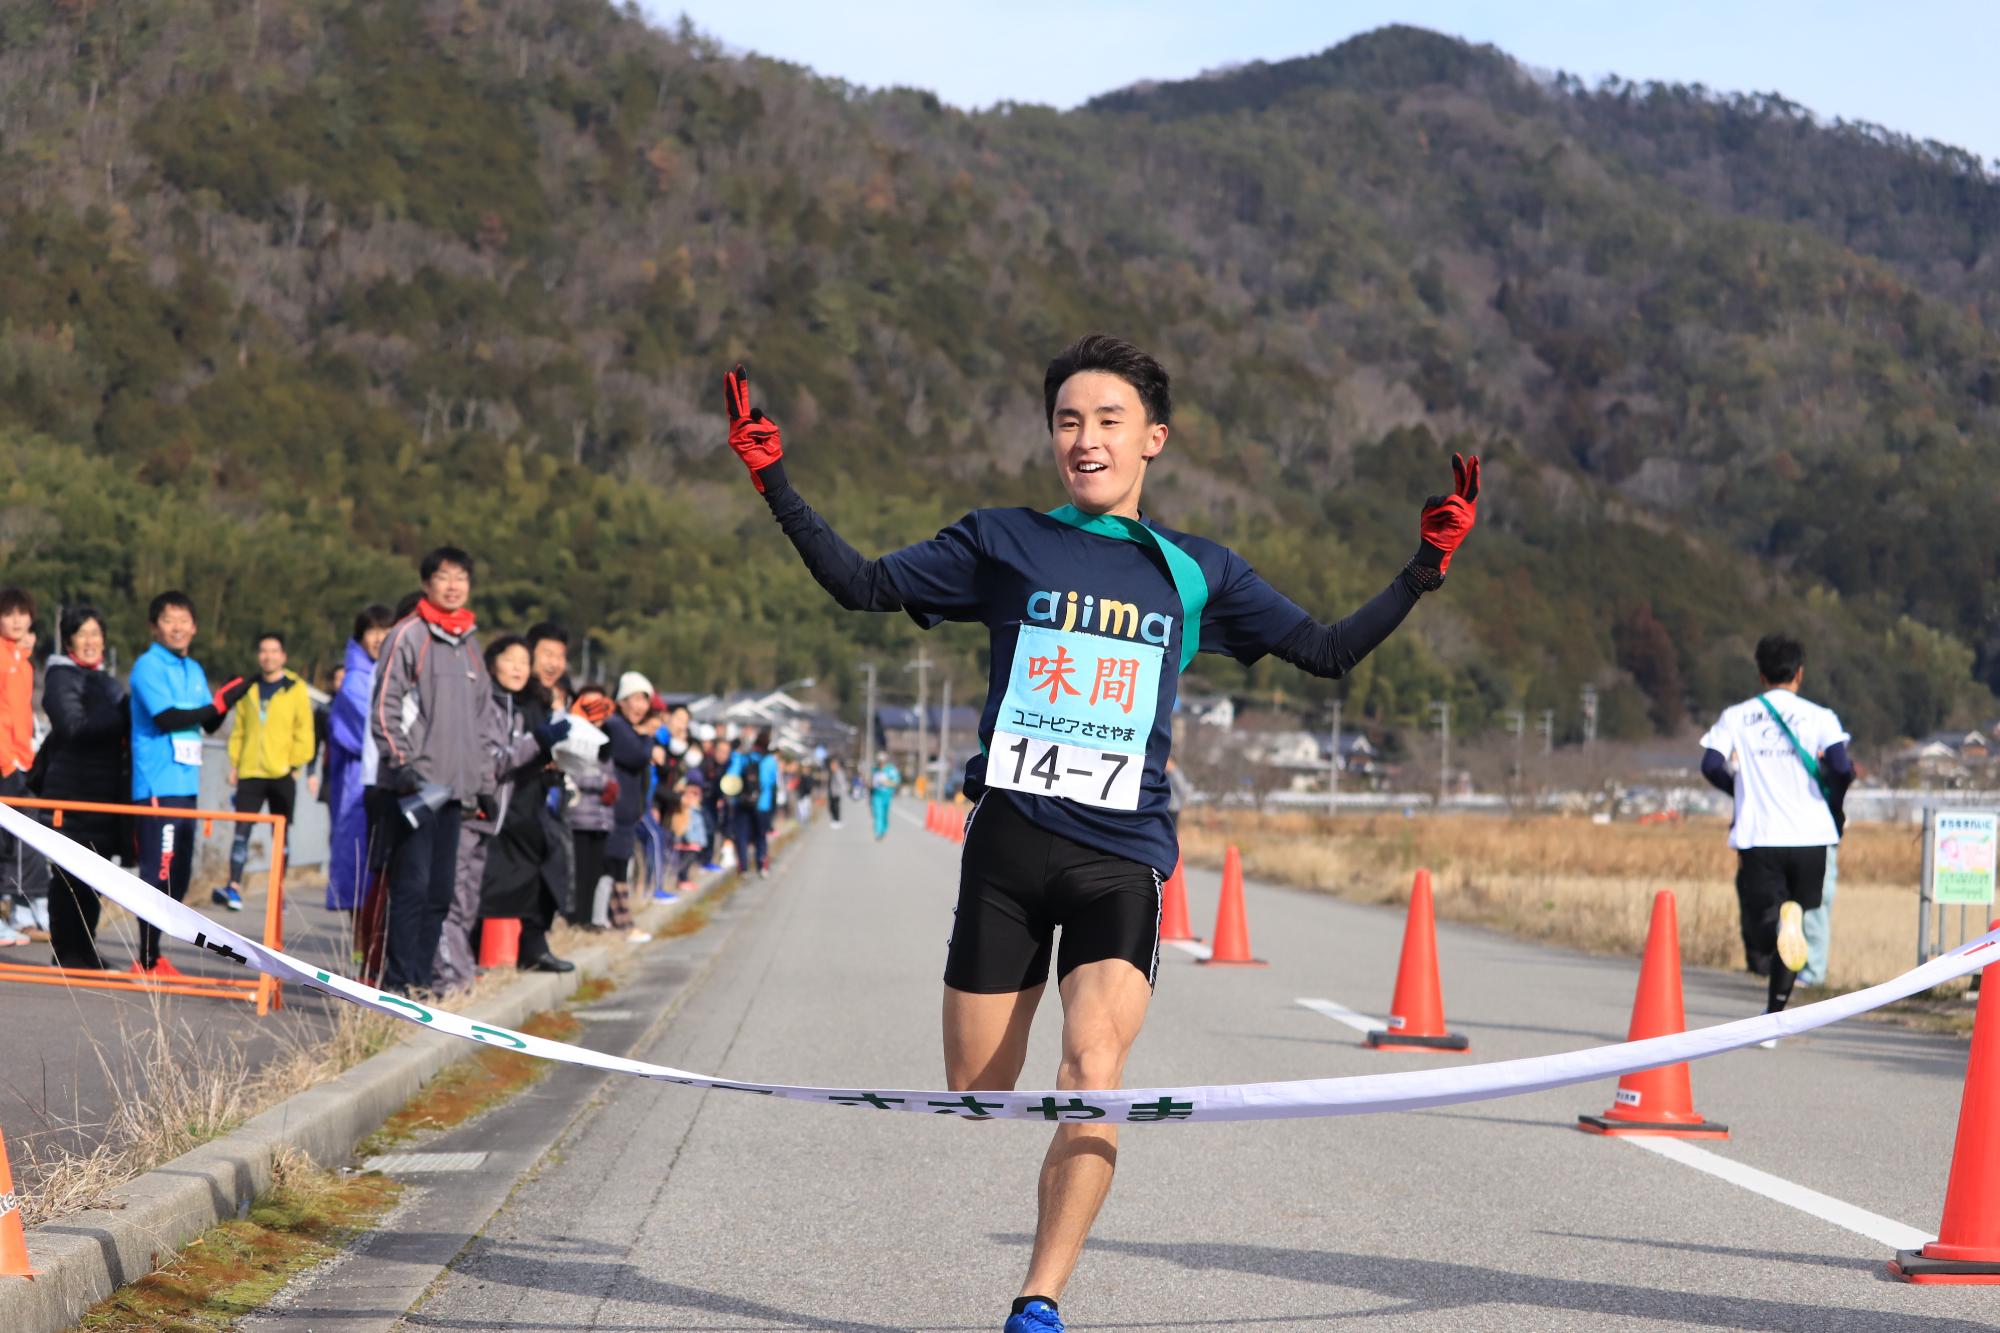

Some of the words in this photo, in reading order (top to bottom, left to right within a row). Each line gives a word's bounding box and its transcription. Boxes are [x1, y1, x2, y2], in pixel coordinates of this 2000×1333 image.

[1026, 590, 1174, 647] ajima
[1028, 645, 1141, 714] 味間
[1011, 709, 1137, 743] ユニトピアささやま
[1009, 736, 1130, 801] 14-7
